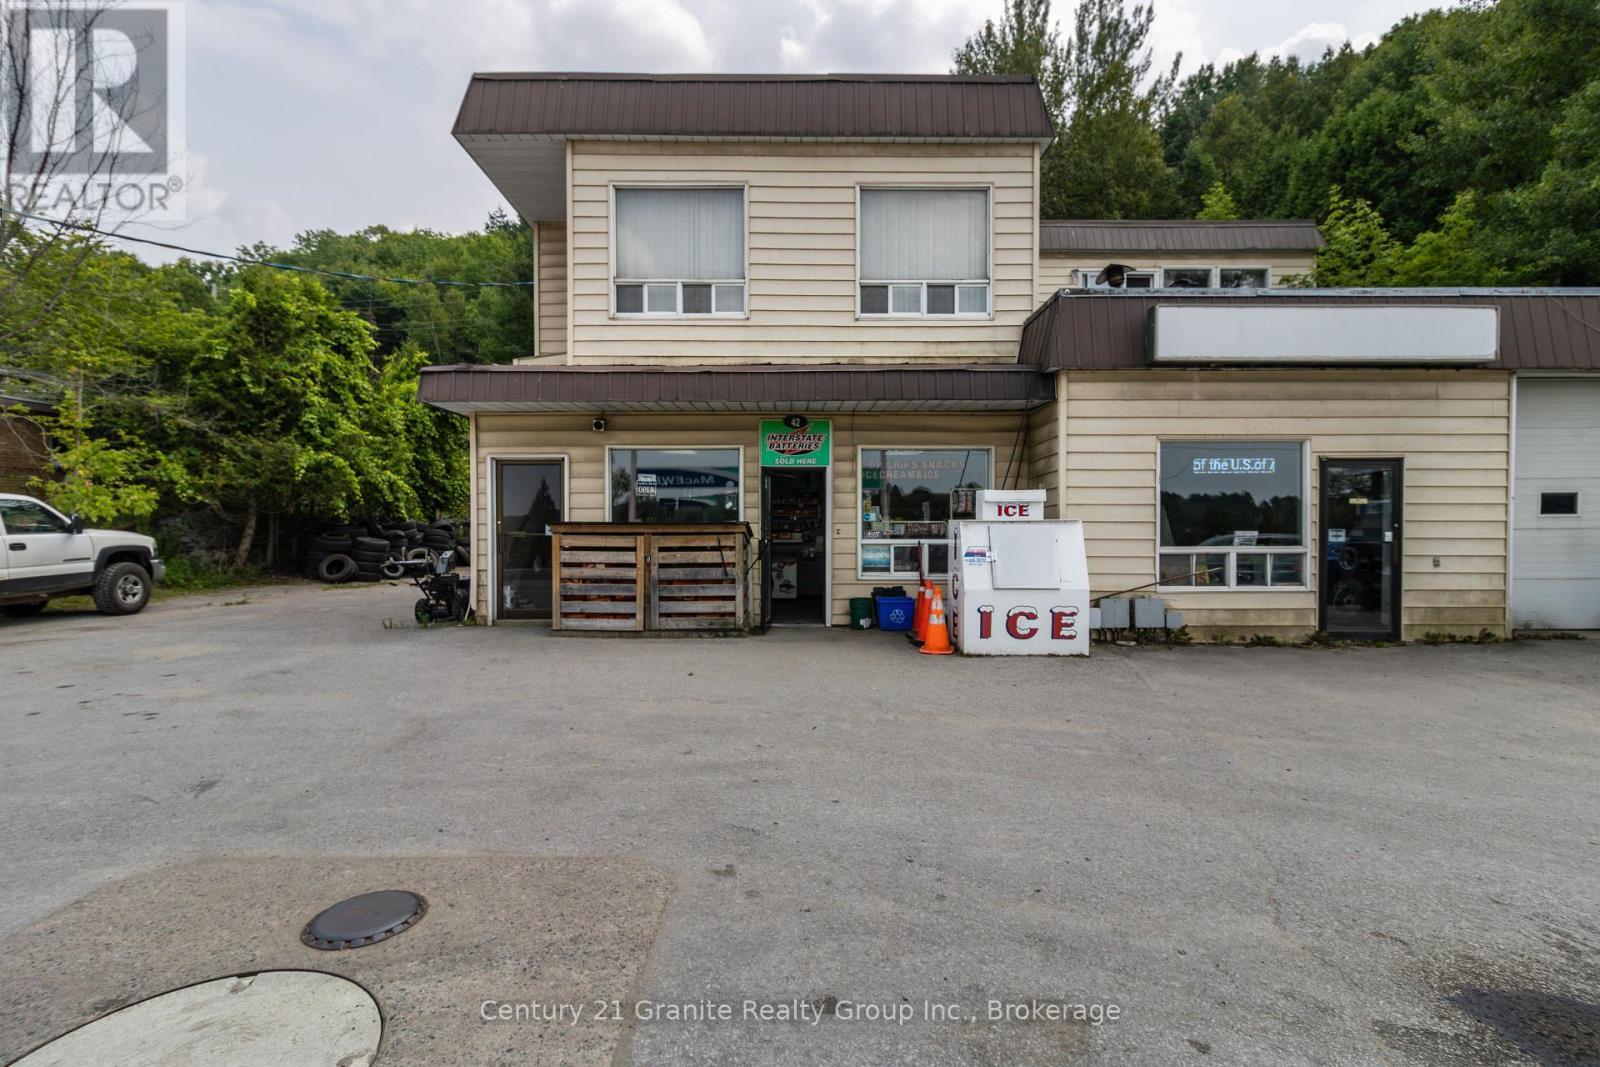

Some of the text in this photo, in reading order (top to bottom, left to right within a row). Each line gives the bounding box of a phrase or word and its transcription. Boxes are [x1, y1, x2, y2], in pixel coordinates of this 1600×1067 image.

[791, 417, 801, 427] 42
[767, 434, 824, 442] INTERSTATE
[768, 442, 820, 450] BATTERIES
[1209, 458, 1228, 471] the
[638, 486, 655, 494] OPEN
[997, 503, 1030, 517] ICE
[977, 604, 1080, 640] ICE
